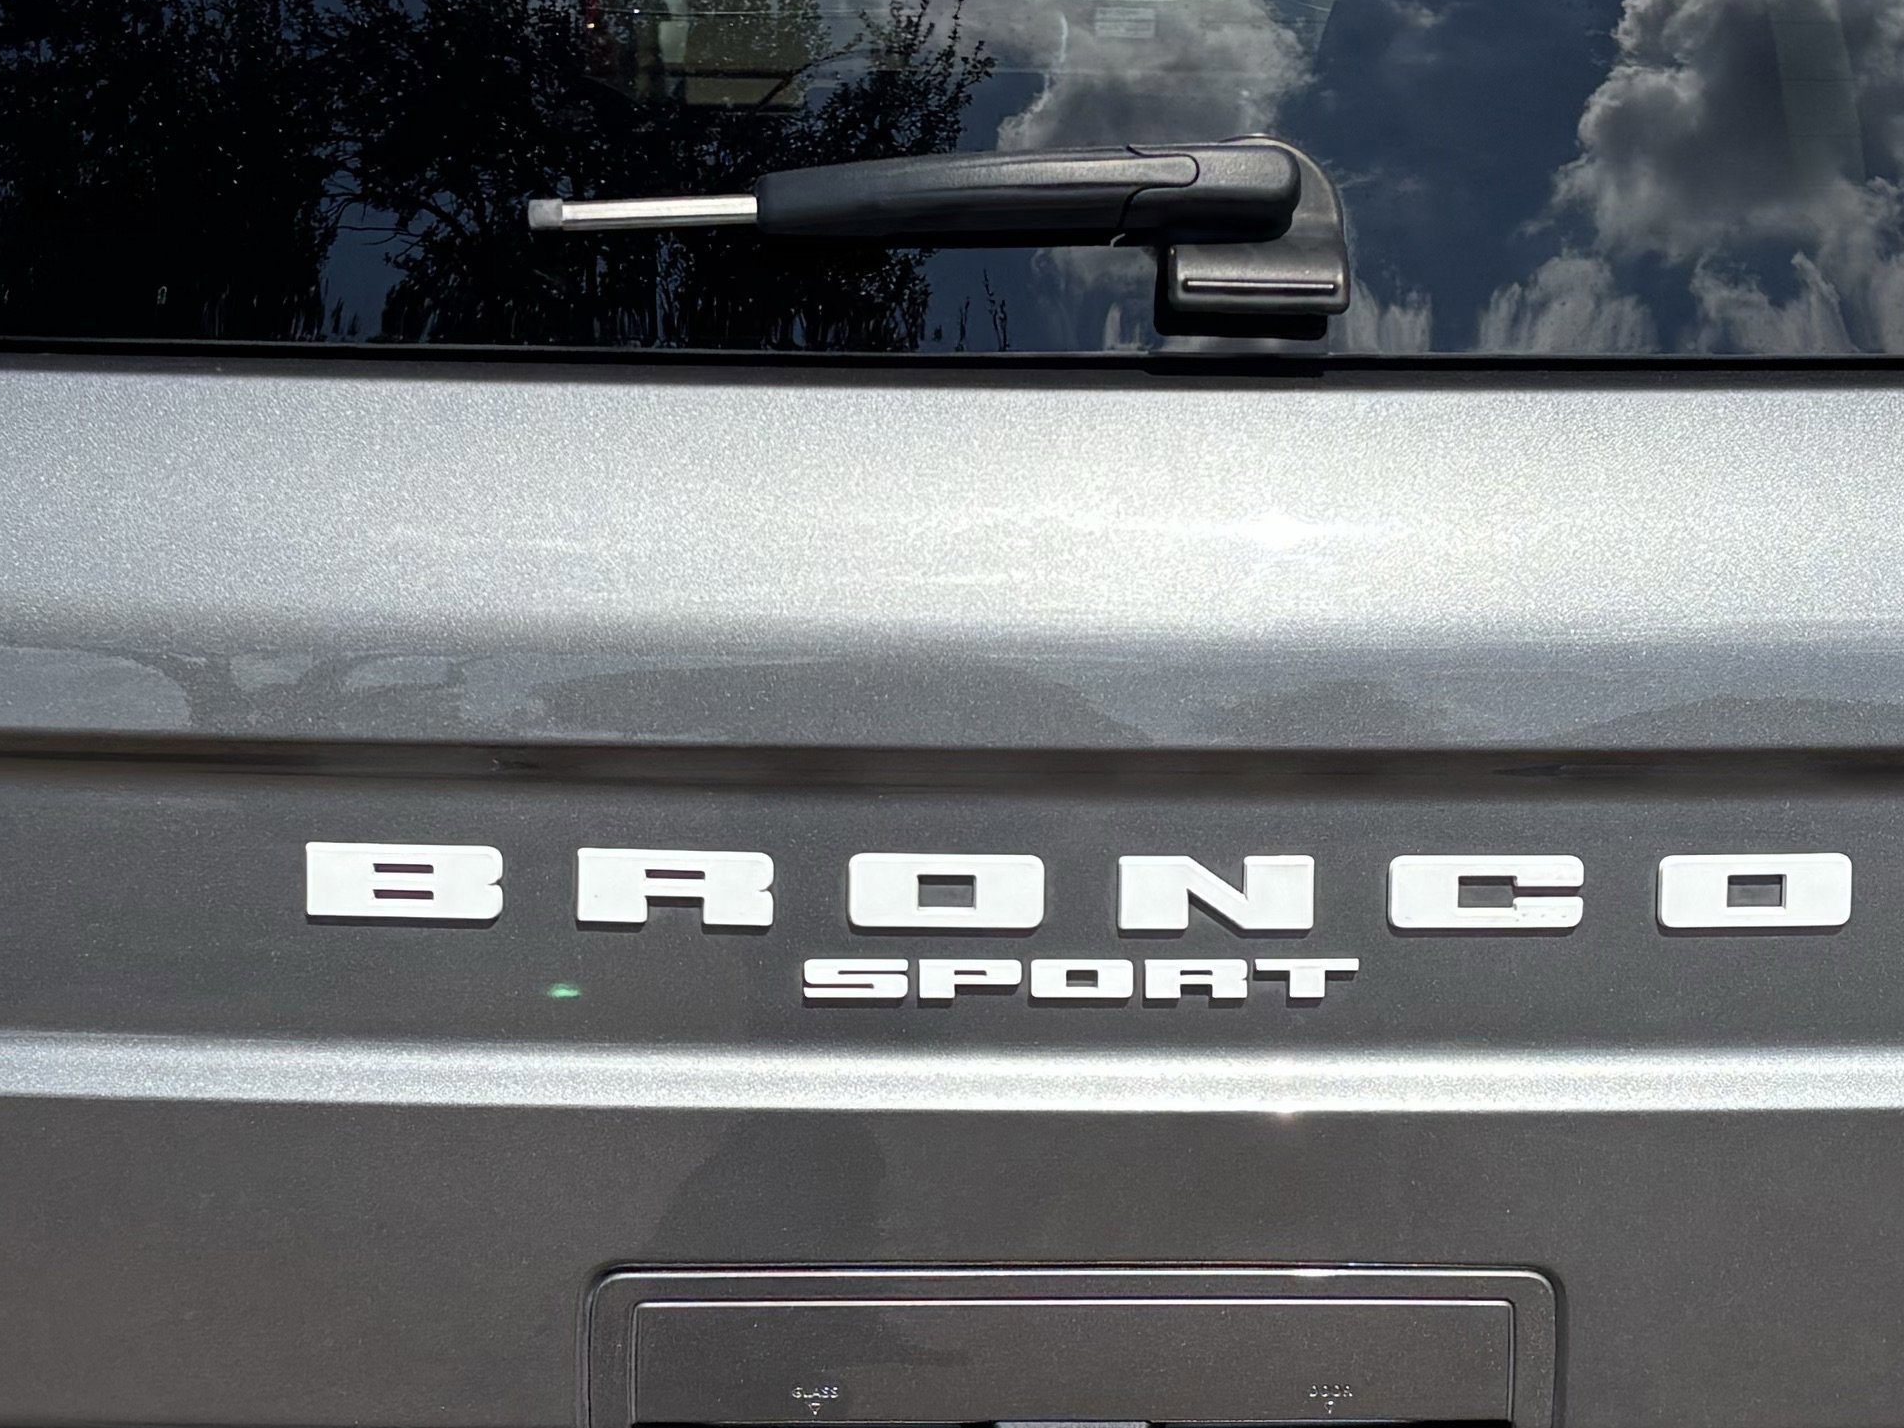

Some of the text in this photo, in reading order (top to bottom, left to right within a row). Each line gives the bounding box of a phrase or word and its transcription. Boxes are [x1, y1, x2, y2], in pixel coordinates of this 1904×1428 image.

[305, 841, 1853, 930] BRONCO
[803, 958, 1360, 999] SPORT
[792, 1386, 839, 1399] GLASS
[1309, 1384, 1353, 1398] DOOR
